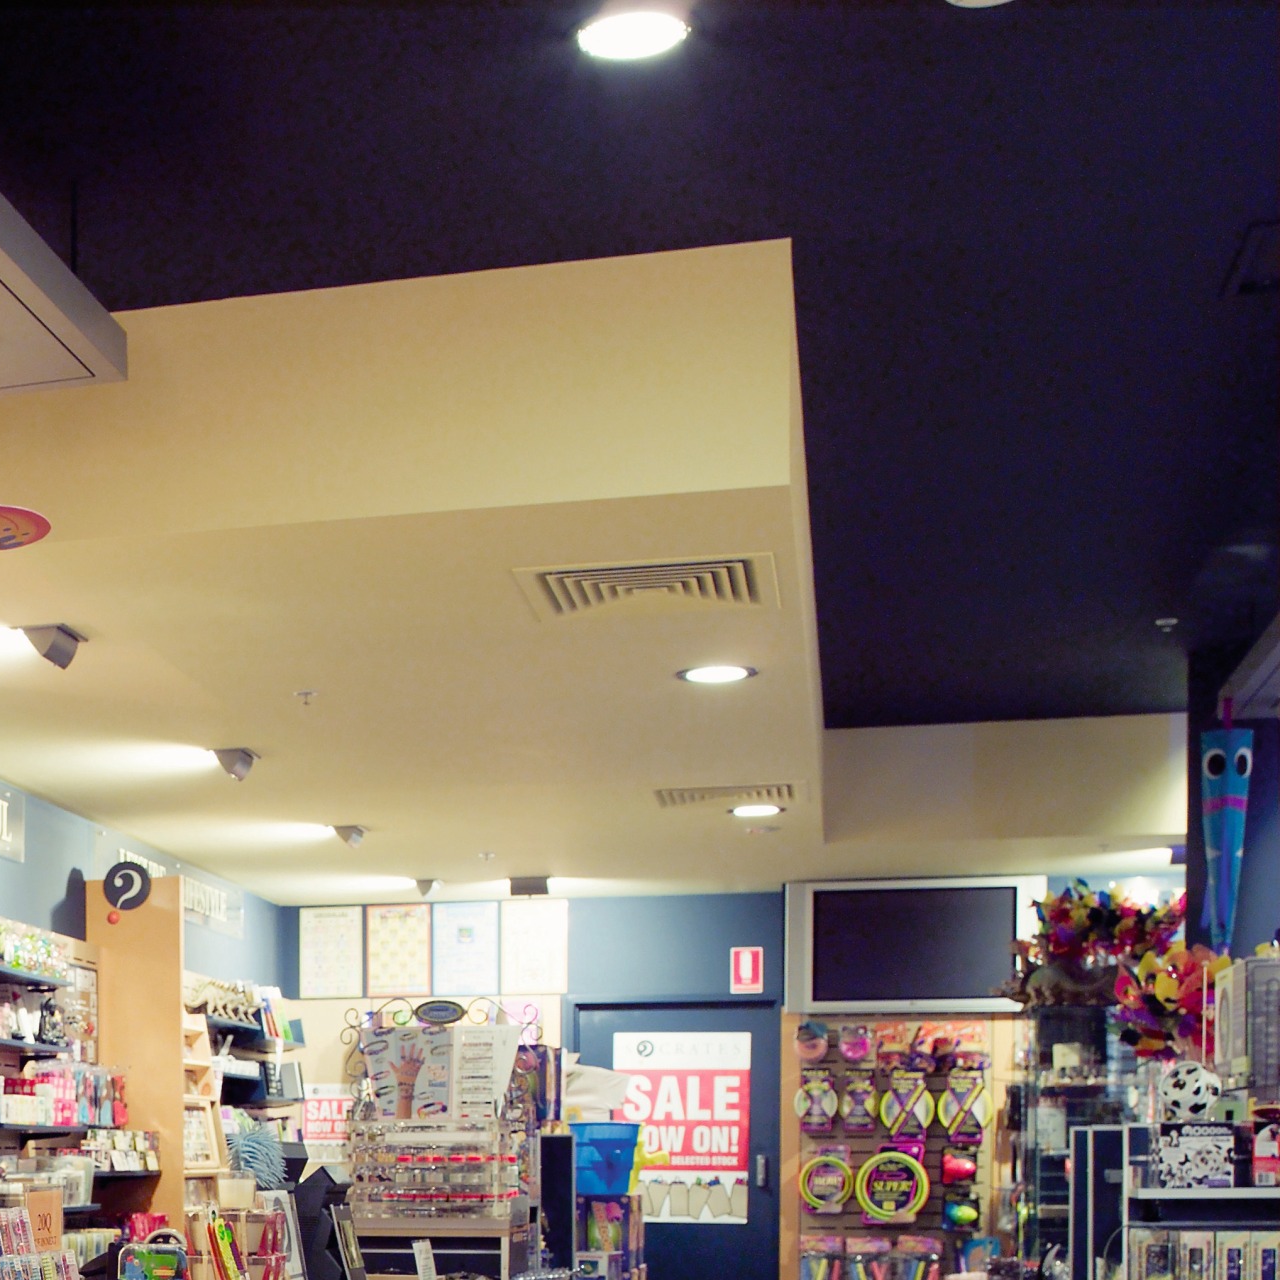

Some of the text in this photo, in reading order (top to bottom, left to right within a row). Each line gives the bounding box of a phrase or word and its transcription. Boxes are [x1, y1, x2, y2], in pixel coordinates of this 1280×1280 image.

[622, 1075, 740, 1121] SALE
[643, 1125, 739, 1153] OW ON!
